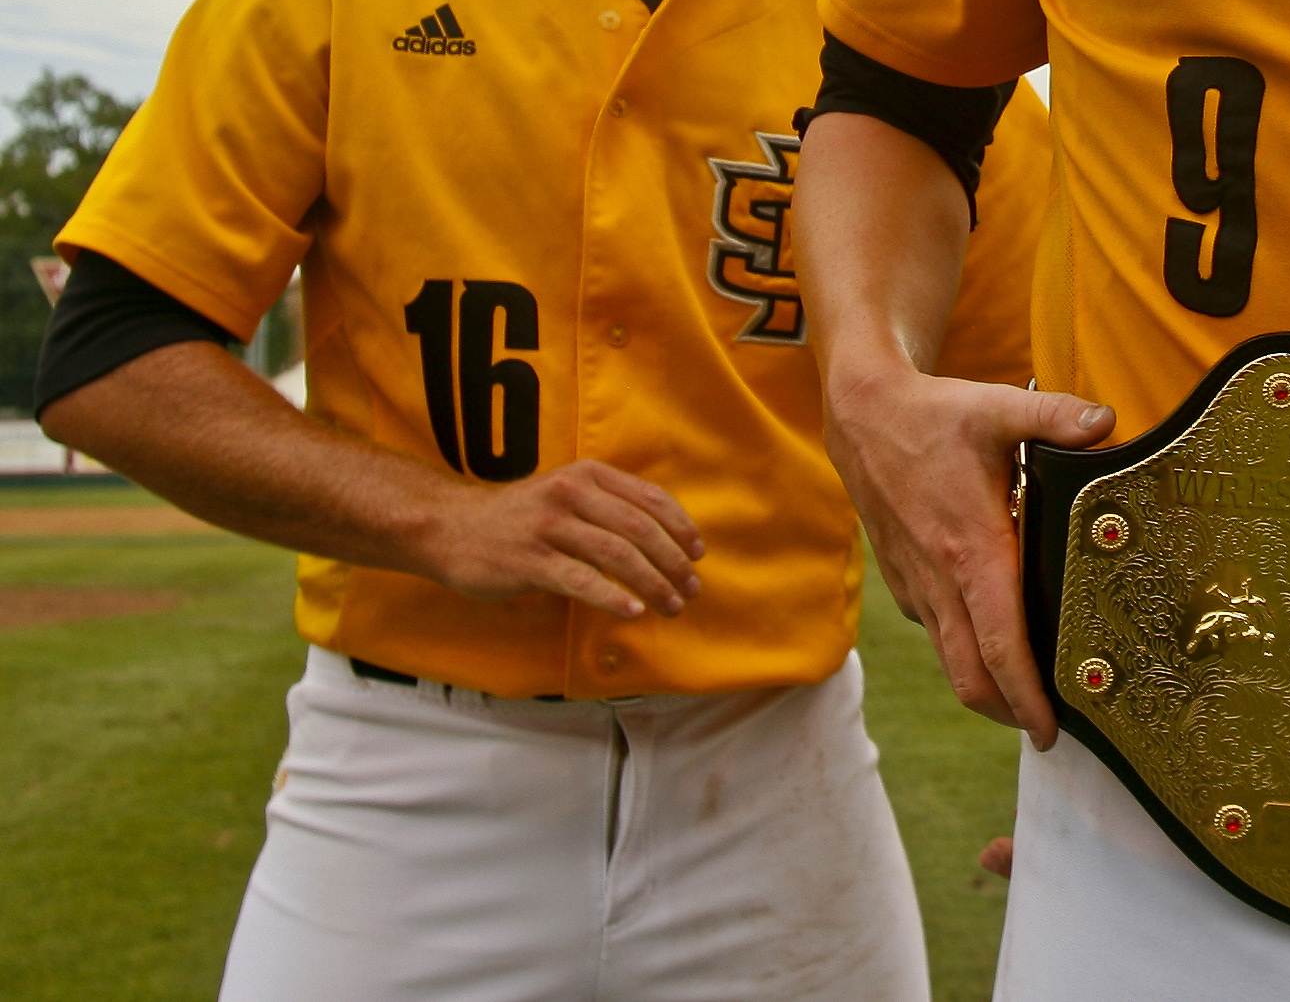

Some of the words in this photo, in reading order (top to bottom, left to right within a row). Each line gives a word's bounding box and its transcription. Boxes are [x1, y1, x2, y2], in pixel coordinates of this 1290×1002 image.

[392, 36, 476, 56] adidas
[1163, 56, 1266, 318] 9
[404, 279, 540, 482] 16
